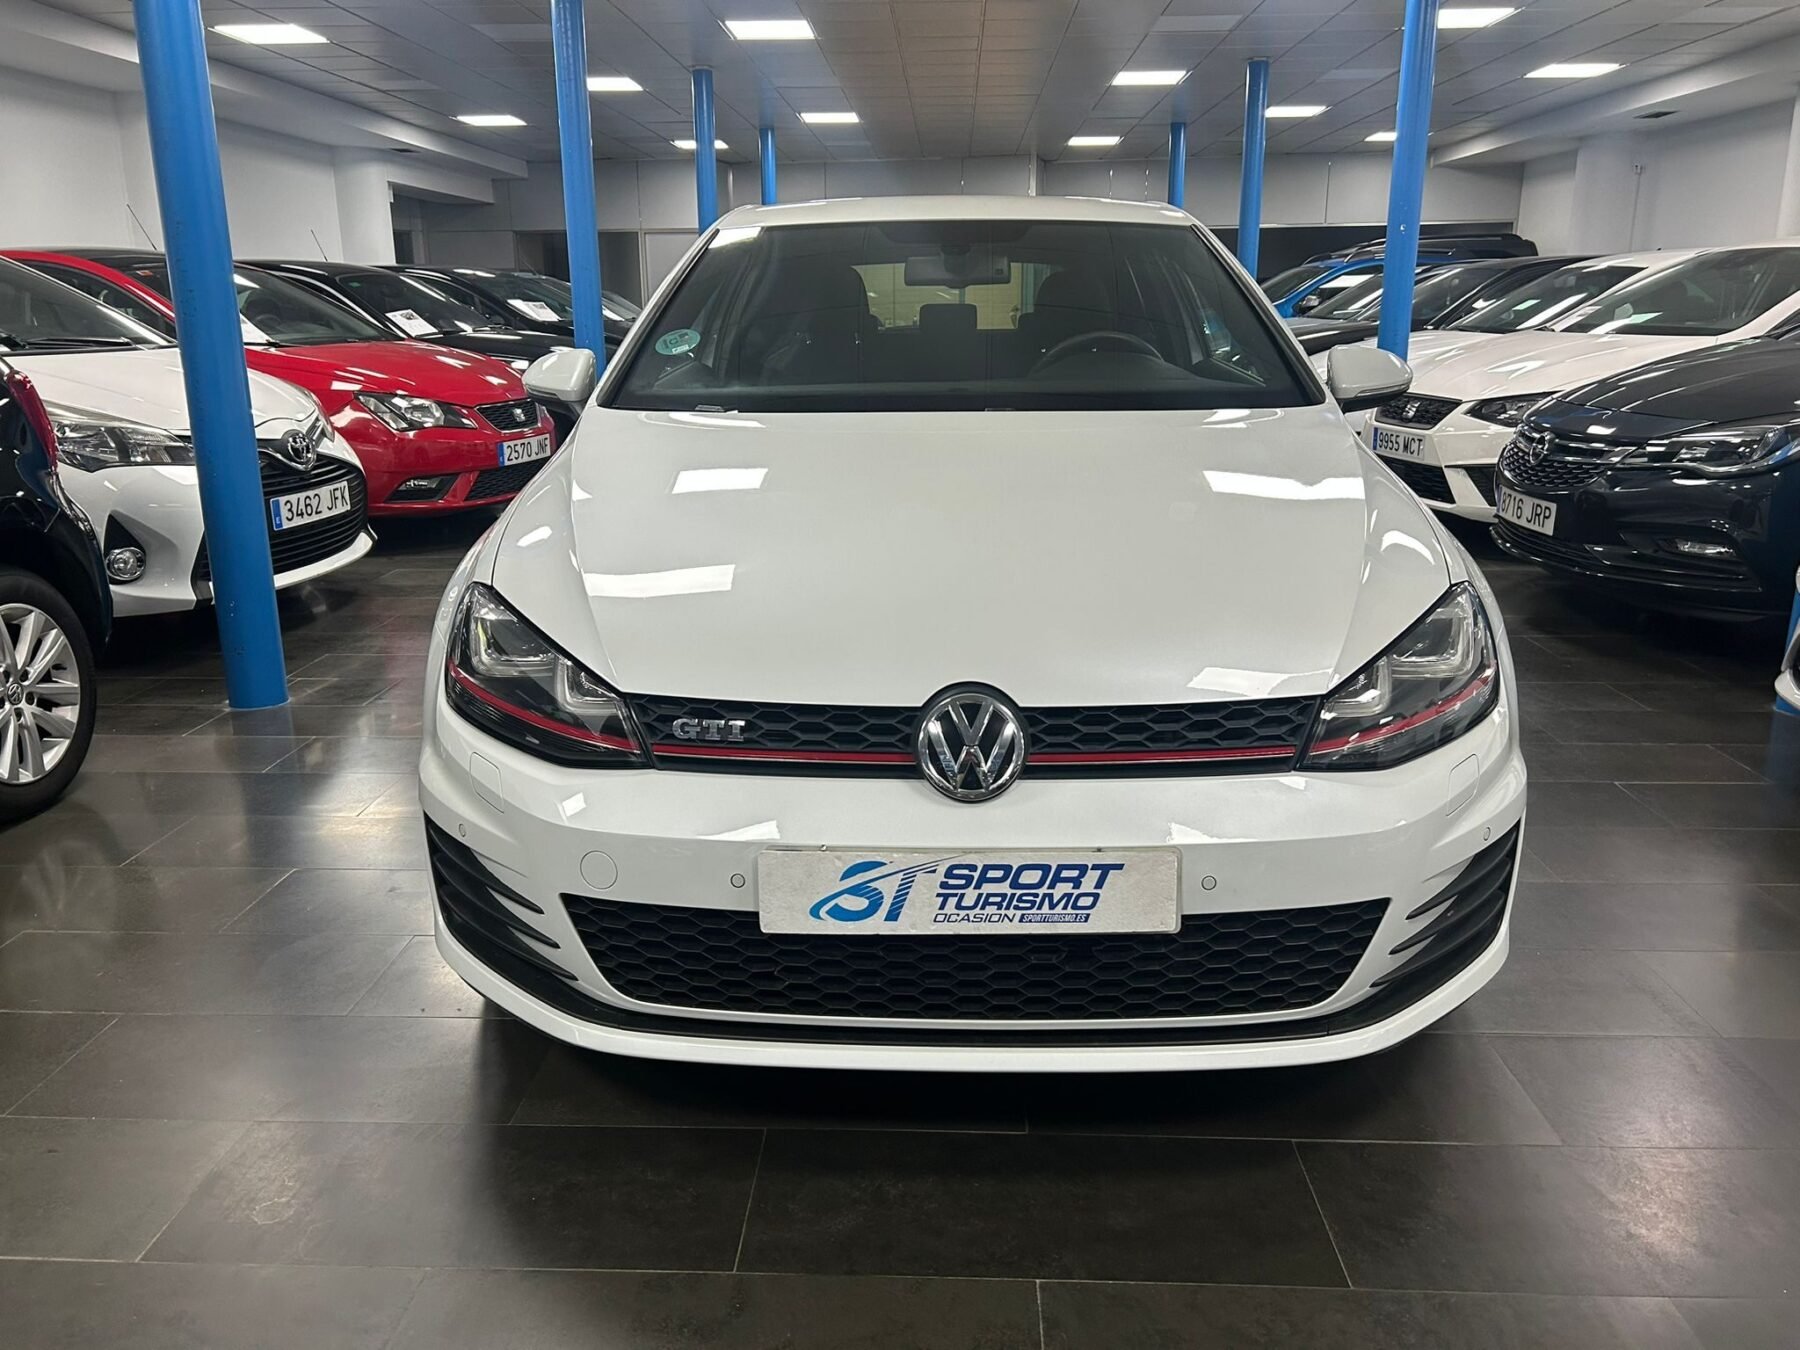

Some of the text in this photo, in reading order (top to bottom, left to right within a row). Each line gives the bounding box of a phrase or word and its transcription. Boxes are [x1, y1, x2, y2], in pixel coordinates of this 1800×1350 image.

[506, 437, 549, 462] 2570 JNF
[1378, 431, 1423, 456] 9955 MCT
[284, 485, 349, 522] 3462 JFK
[1501, 491, 1552, 528] 8716 JRP
[671, 718, 746, 742] GTI
[938, 863, 1125, 891] SPORT
[935, 892, 1101, 911] TURISMO
[932, 912, 1087, 923] OCASION SPORTTURISMO.ES
